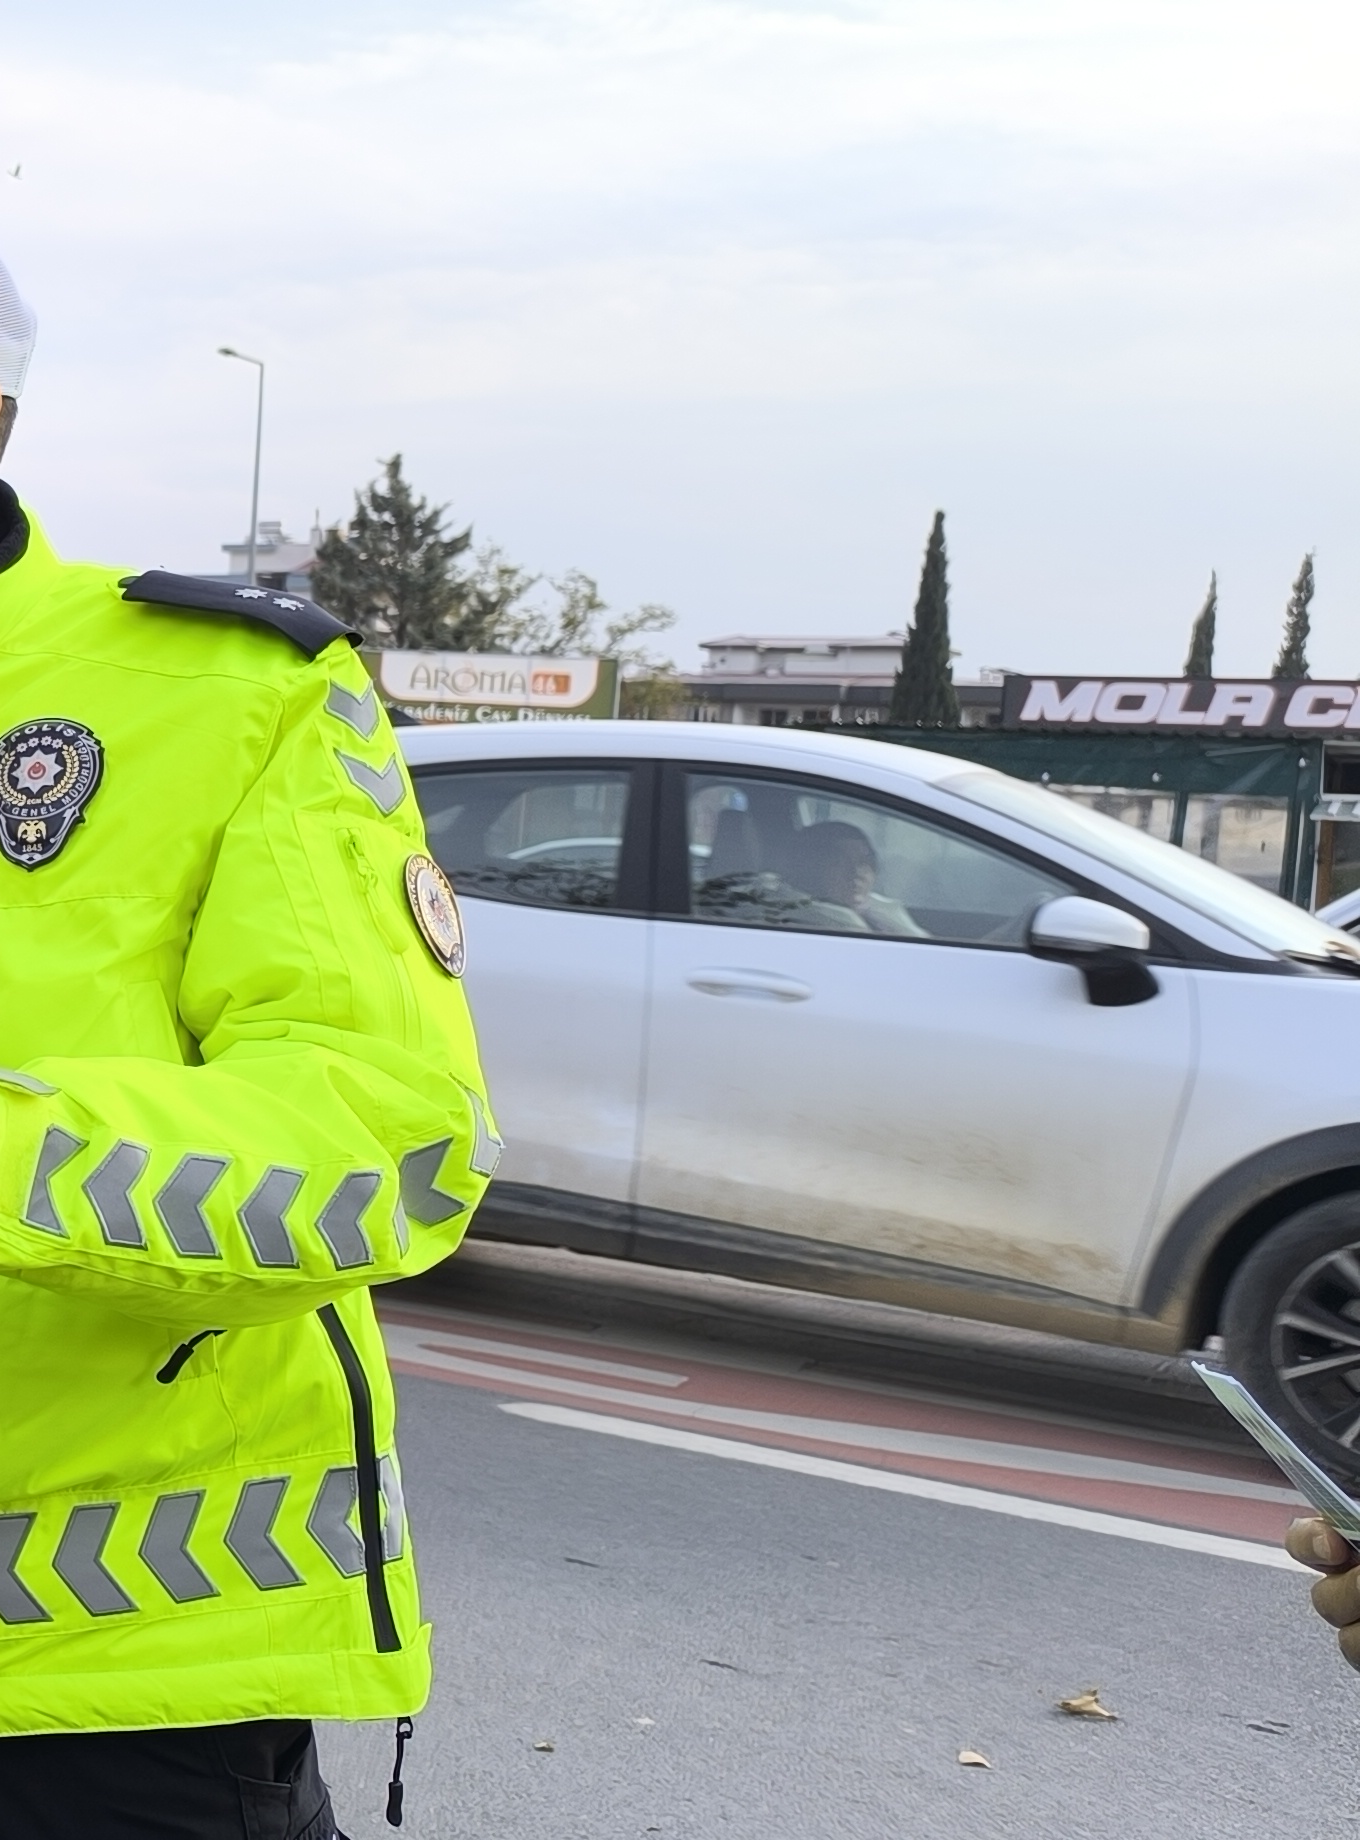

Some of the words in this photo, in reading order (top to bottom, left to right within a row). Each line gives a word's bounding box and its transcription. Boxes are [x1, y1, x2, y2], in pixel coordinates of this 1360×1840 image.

[409, 662, 527, 697] AROMA
[1019, 679, 1274, 727] MOLA
[11, 804, 57, 817] GENEL
[21, 844, 44, 854] 1845
